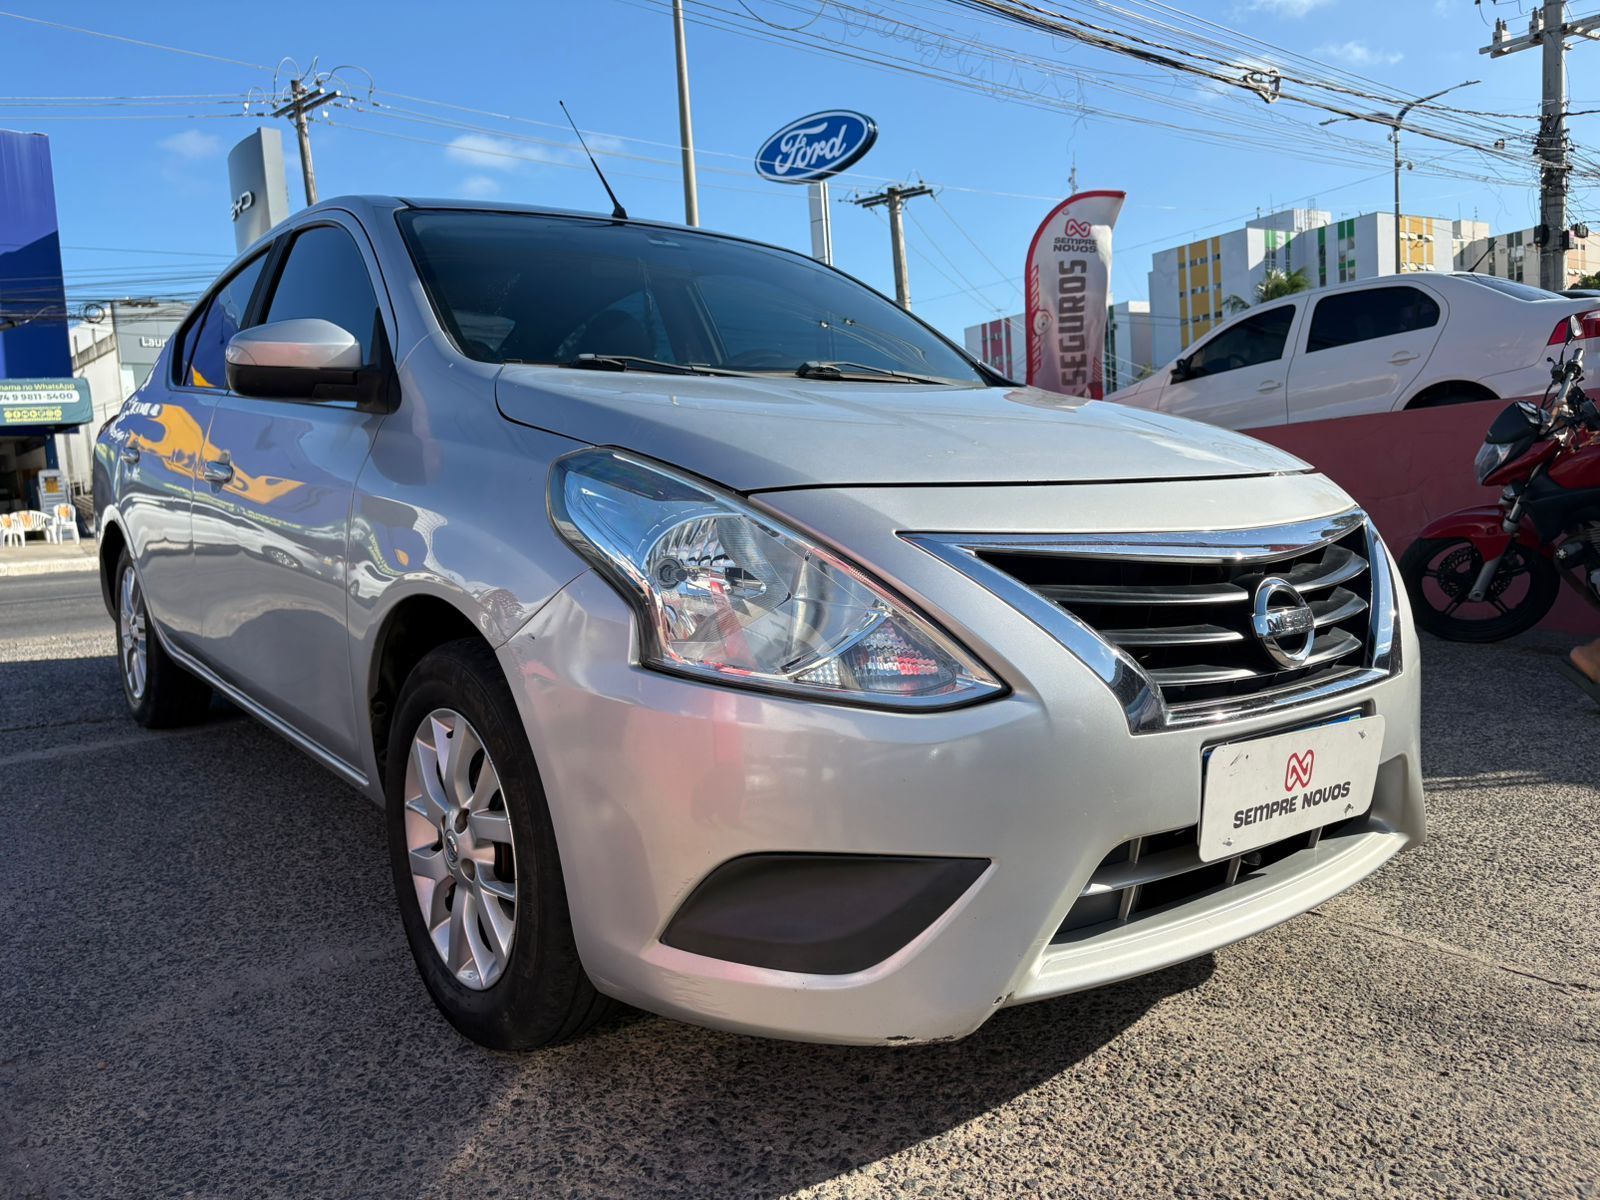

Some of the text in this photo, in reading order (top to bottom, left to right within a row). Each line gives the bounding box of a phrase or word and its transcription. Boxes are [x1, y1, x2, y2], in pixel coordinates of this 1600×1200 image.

[774, 122, 847, 174] Ford
[1054, 236, 1098, 246] SEMPRE
[1058, 259, 1087, 387] SEGUROS
[34, 383, 75, 391] WhatsApp
[1233, 795, 1298, 829] SEMPRE
